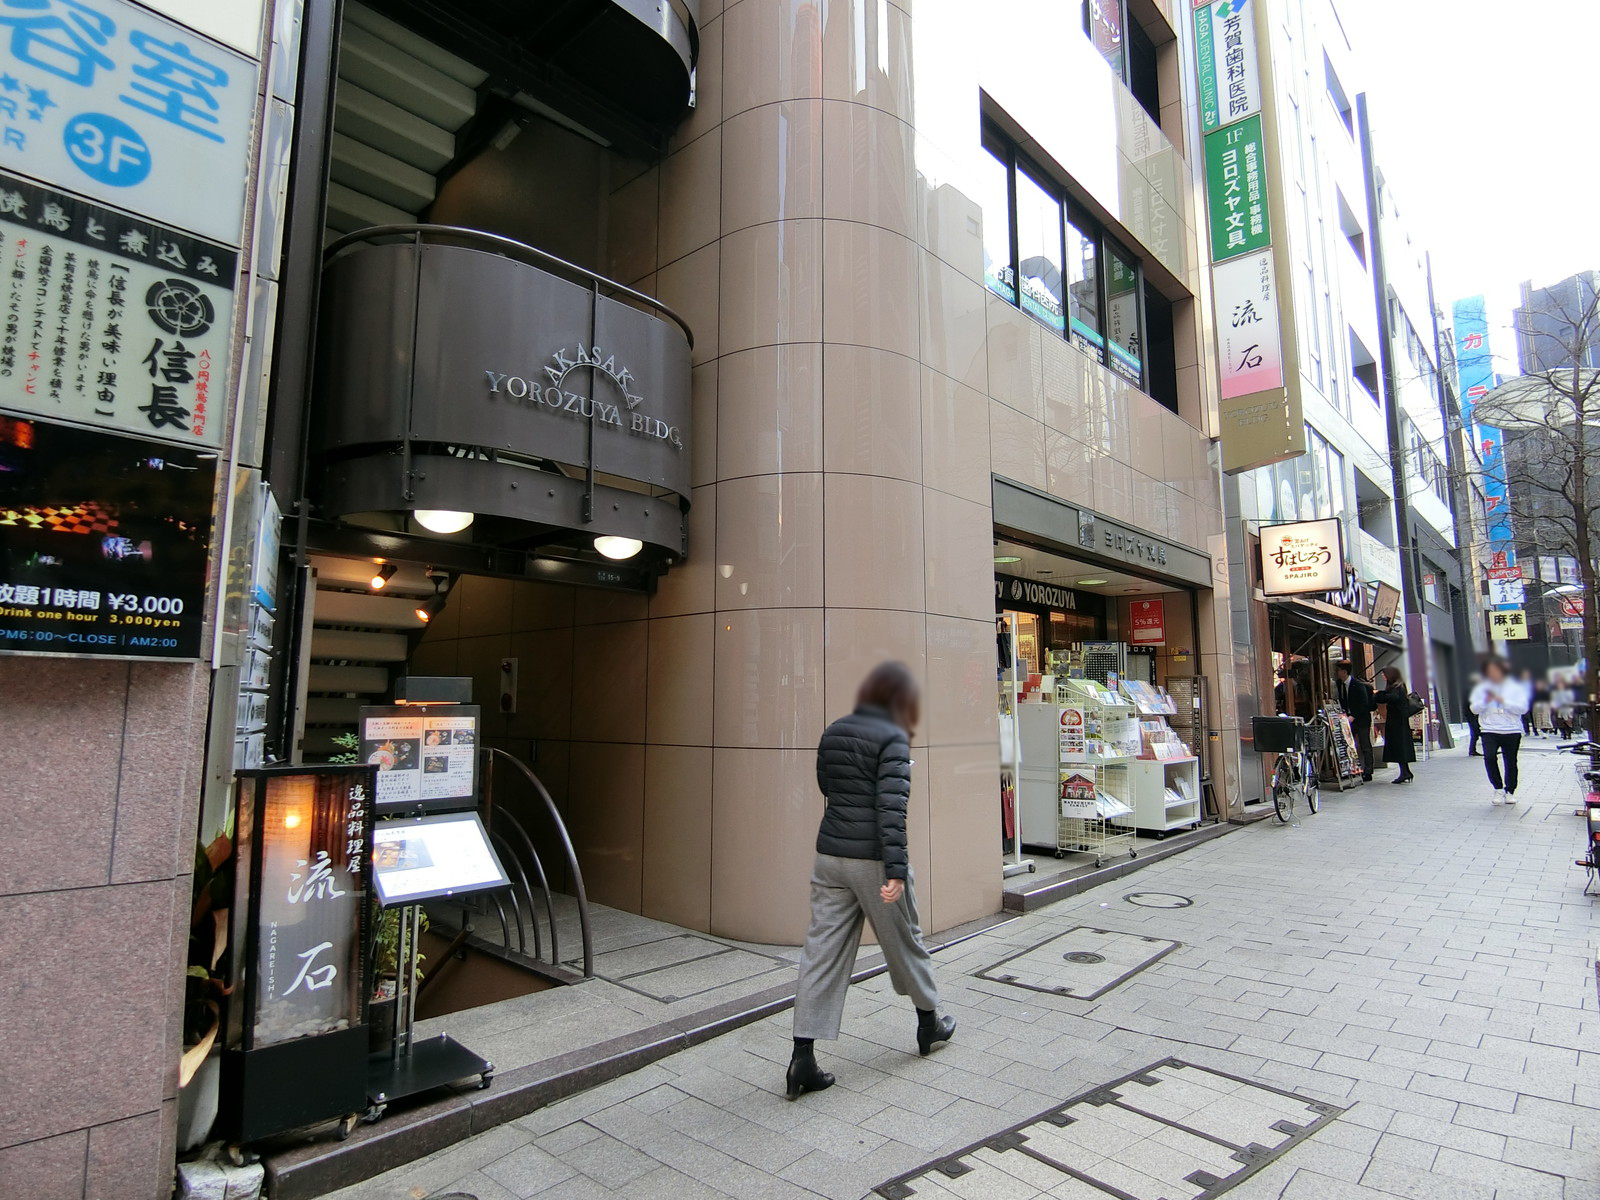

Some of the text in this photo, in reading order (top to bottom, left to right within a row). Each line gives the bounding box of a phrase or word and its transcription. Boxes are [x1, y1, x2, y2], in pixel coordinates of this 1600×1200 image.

[1197, 9, 1217, 123] HAGA DENTAL CLINIC 2F
[1223, 14, 1249, 117] 芳賀歯科医院
[71, 121, 147, 174] 3F
[1226, 128, 1244, 145] 1F
[1222, 149, 1247, 249] ヨロズヤ文具
[1244, 142, 1264, 236] 総合事務用品・事務機
[1232, 299, 1263, 373] 流石
[138, 337, 196, 432] 信長
[485, 370, 623, 427] YOROZUYA
[544, 342, 644, 410] AKASAKA
[108, 592, 184, 615] ¥3,000
[1023, 582, 1077, 610] YOROZUYA
[1284, 571, 1319, 580] SPAJIRO
[37, 610, 63, 620] one
[66, 612, 99, 622] hour
[109, 613, 181, 628] 3,000yen
[130, 636, 178, 648] AM2:00
[1494, 612, 1524, 627] 麻雀
[1503, 627, 1516, 638] 北
[345, 784, 367, 873] 逸品料理屋
[281, 850, 346, 996] 流石
[268, 921, 278, 1000] NAGAREISHI
